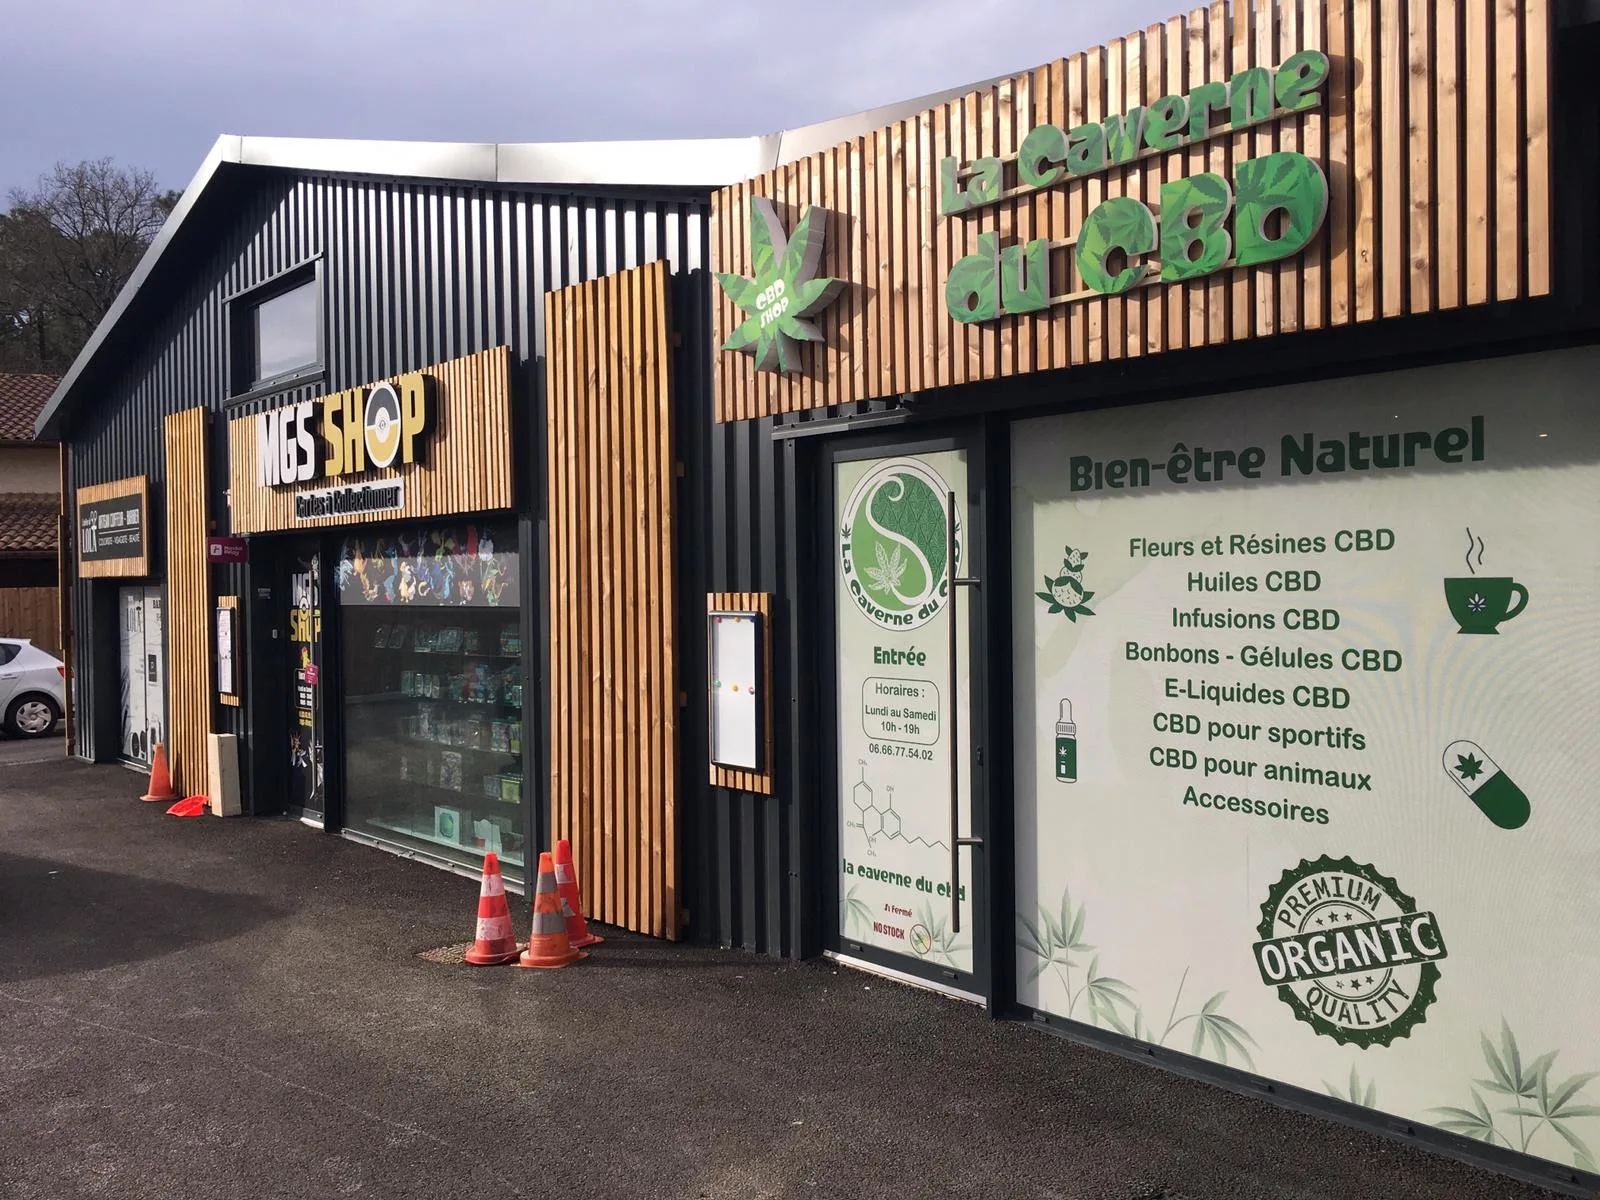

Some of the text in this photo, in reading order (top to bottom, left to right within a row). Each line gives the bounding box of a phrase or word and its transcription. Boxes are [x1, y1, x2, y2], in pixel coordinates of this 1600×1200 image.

[941, 50, 1329, 216] La Caverne
[946, 151, 1329, 323] du CBD
[756, 279, 785, 310] CBD
[760, 297, 789, 328] SHOP
[257, 373, 425, 486] MGS SHOP
[1069, 415, 1484, 492] Bien-être Naturel
[1130, 528, 1395, 557] Fleurs et Résines CBD
[840, 543, 851, 574] La
[918, 599, 939, 620] du
[1188, 570, 1321, 592] Huiles CBD
[1172, 607, 1340, 630] Infusions CBD
[874, 646, 926, 666] Entrée
[1125, 641, 1219, 665] Bonbons
[1240, 645, 1333, 669] Gélules
[1341, 649, 1402, 672] CBD
[875, 683, 919, 697] Horaires
[1165, 678, 1350, 709] E-Liquides CBD
[865, 705, 936, 721] Lundi au Samedi
[881, 721, 896, 732] 10h
[904, 723, 920, 735] 19h
[1153, 712, 1366, 750] CBD pour sportifs
[869, 743, 933, 760] 06.66.77.54.02
[1150, 747, 1371, 791] CBD pour animaux
[1183, 786, 1329, 824] Accessoires
[916, 876, 933, 893] du
[1278, 876, 1382, 929] PREMIUM
[873, 921, 905, 939] NO STOCK
[1261, 917, 1441, 981] ORGANIC
[1306, 979, 1410, 1025] QUALITY
